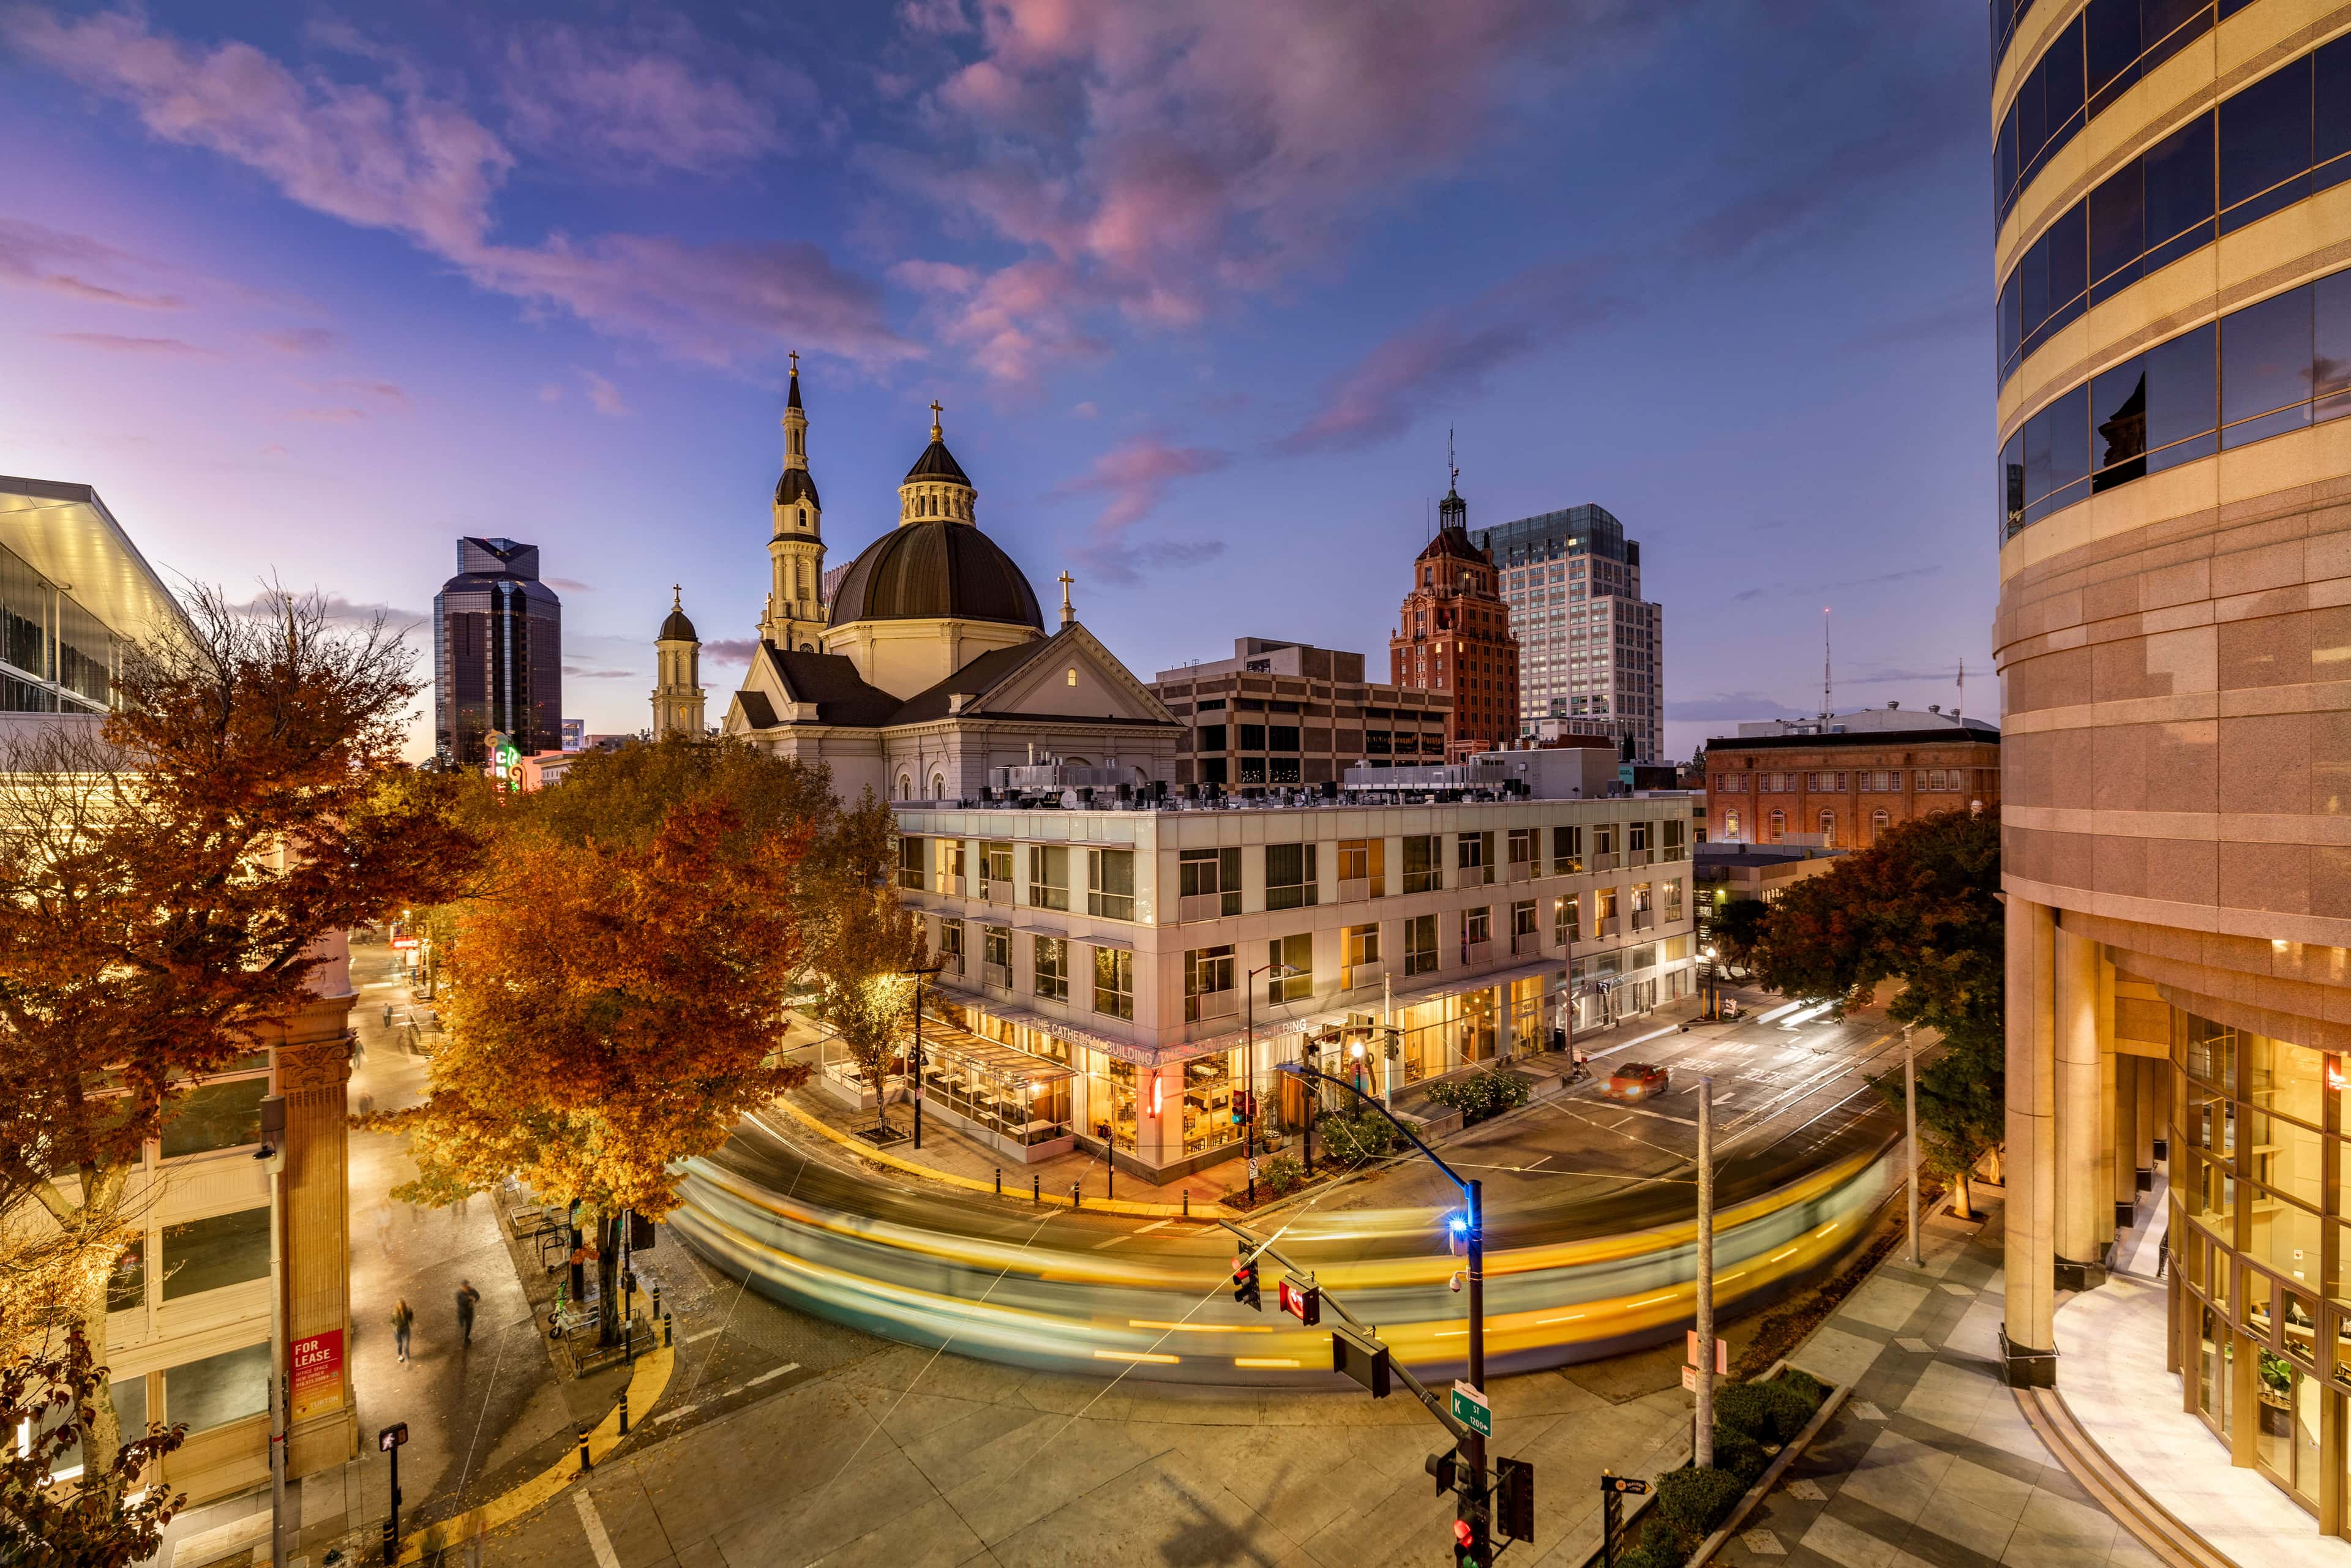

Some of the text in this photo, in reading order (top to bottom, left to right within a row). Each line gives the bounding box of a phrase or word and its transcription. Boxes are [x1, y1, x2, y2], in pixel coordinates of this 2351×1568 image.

[1032, 1017, 1152, 1065] THE CATHEDRAL BUILDING
[295, 1340, 318, 1356] FOR
[295, 1348, 331, 1367] LEASE
[313, 1364, 329, 1372] SPACE
[310, 1395, 339, 1408] TURTON
[1455, 1398, 1480, 1415] K ST
[1470, 1416, 1483, 1430] 1200
